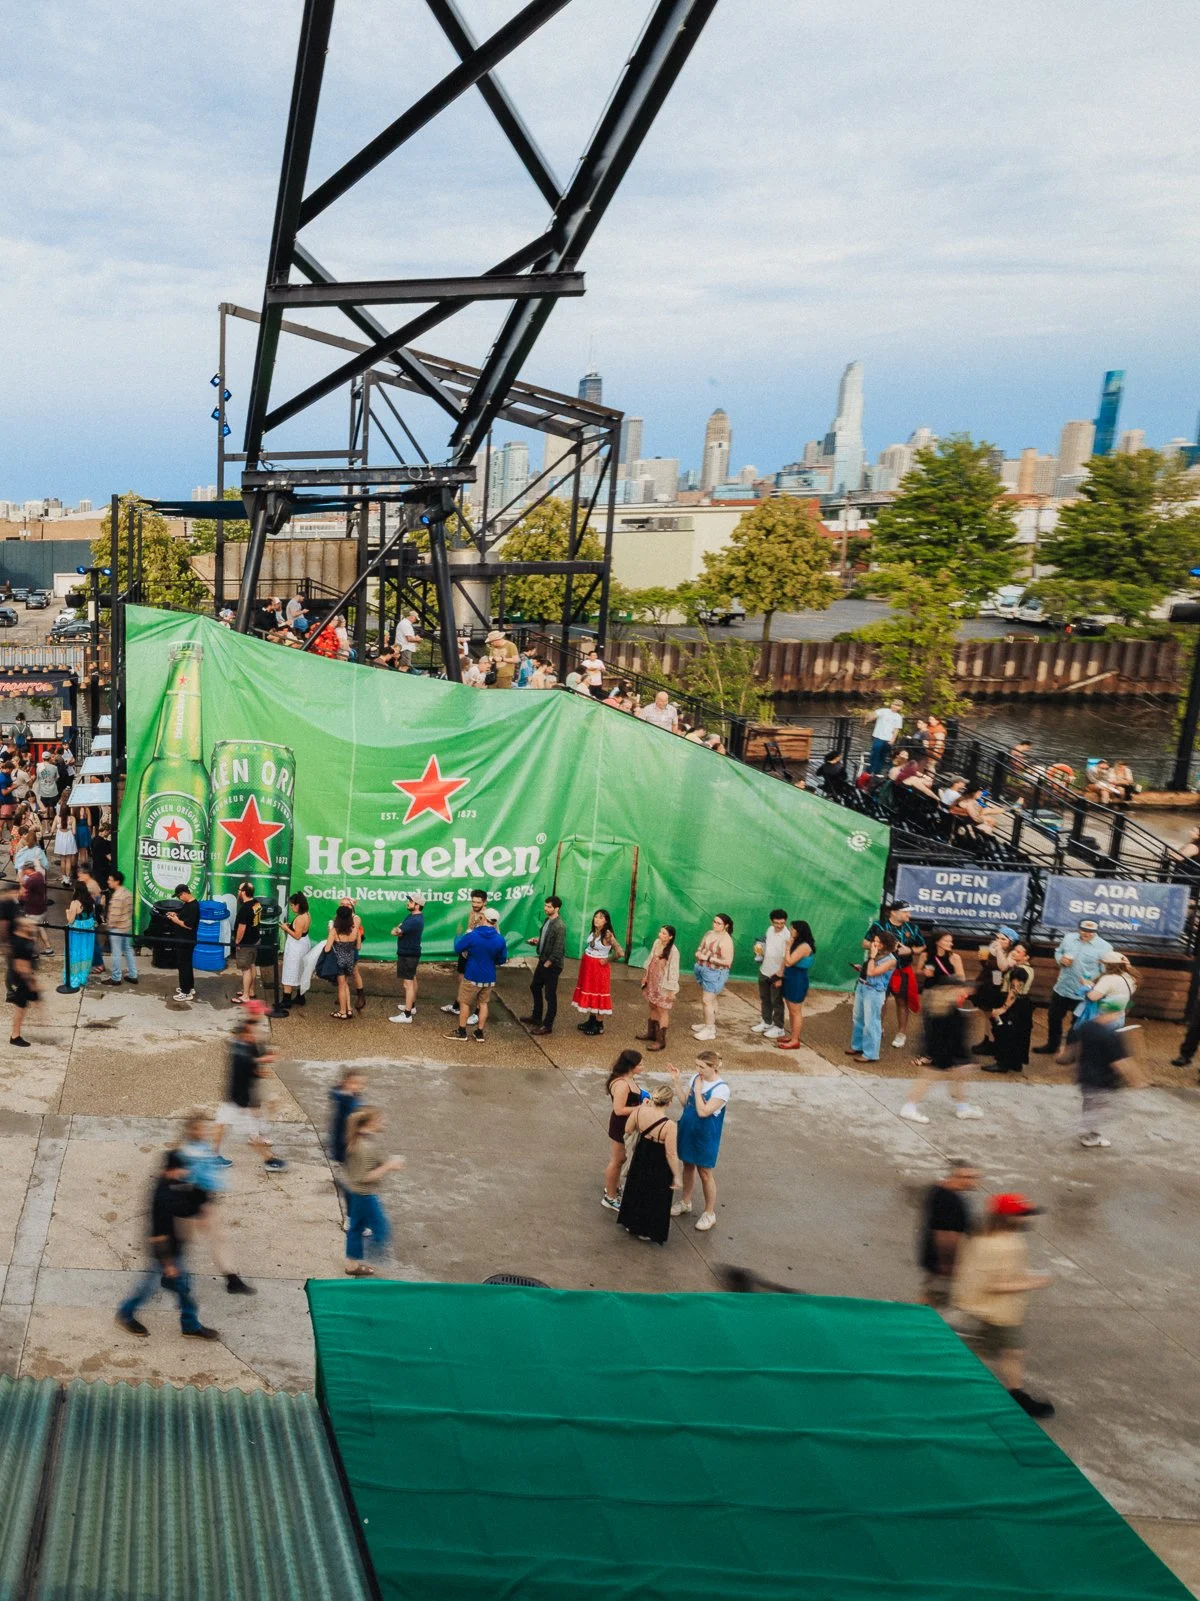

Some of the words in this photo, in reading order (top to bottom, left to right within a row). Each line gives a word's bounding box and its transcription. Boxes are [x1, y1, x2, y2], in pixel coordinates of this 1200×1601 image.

[380, 812, 399, 821] EST.
[935, 872, 988, 888] OPEN
[303, 885, 351, 900] Social
[457, 888, 502, 902] Sice
[918, 888, 1002, 906] SEATING
[1094, 884, 1139, 900] ADA
[938, 906, 976, 917] GRAND
[978, 910, 1018, 920] STAND
[1068, 900, 1161, 920] SEATING
[1098, 920, 1141, 931] FRONT
